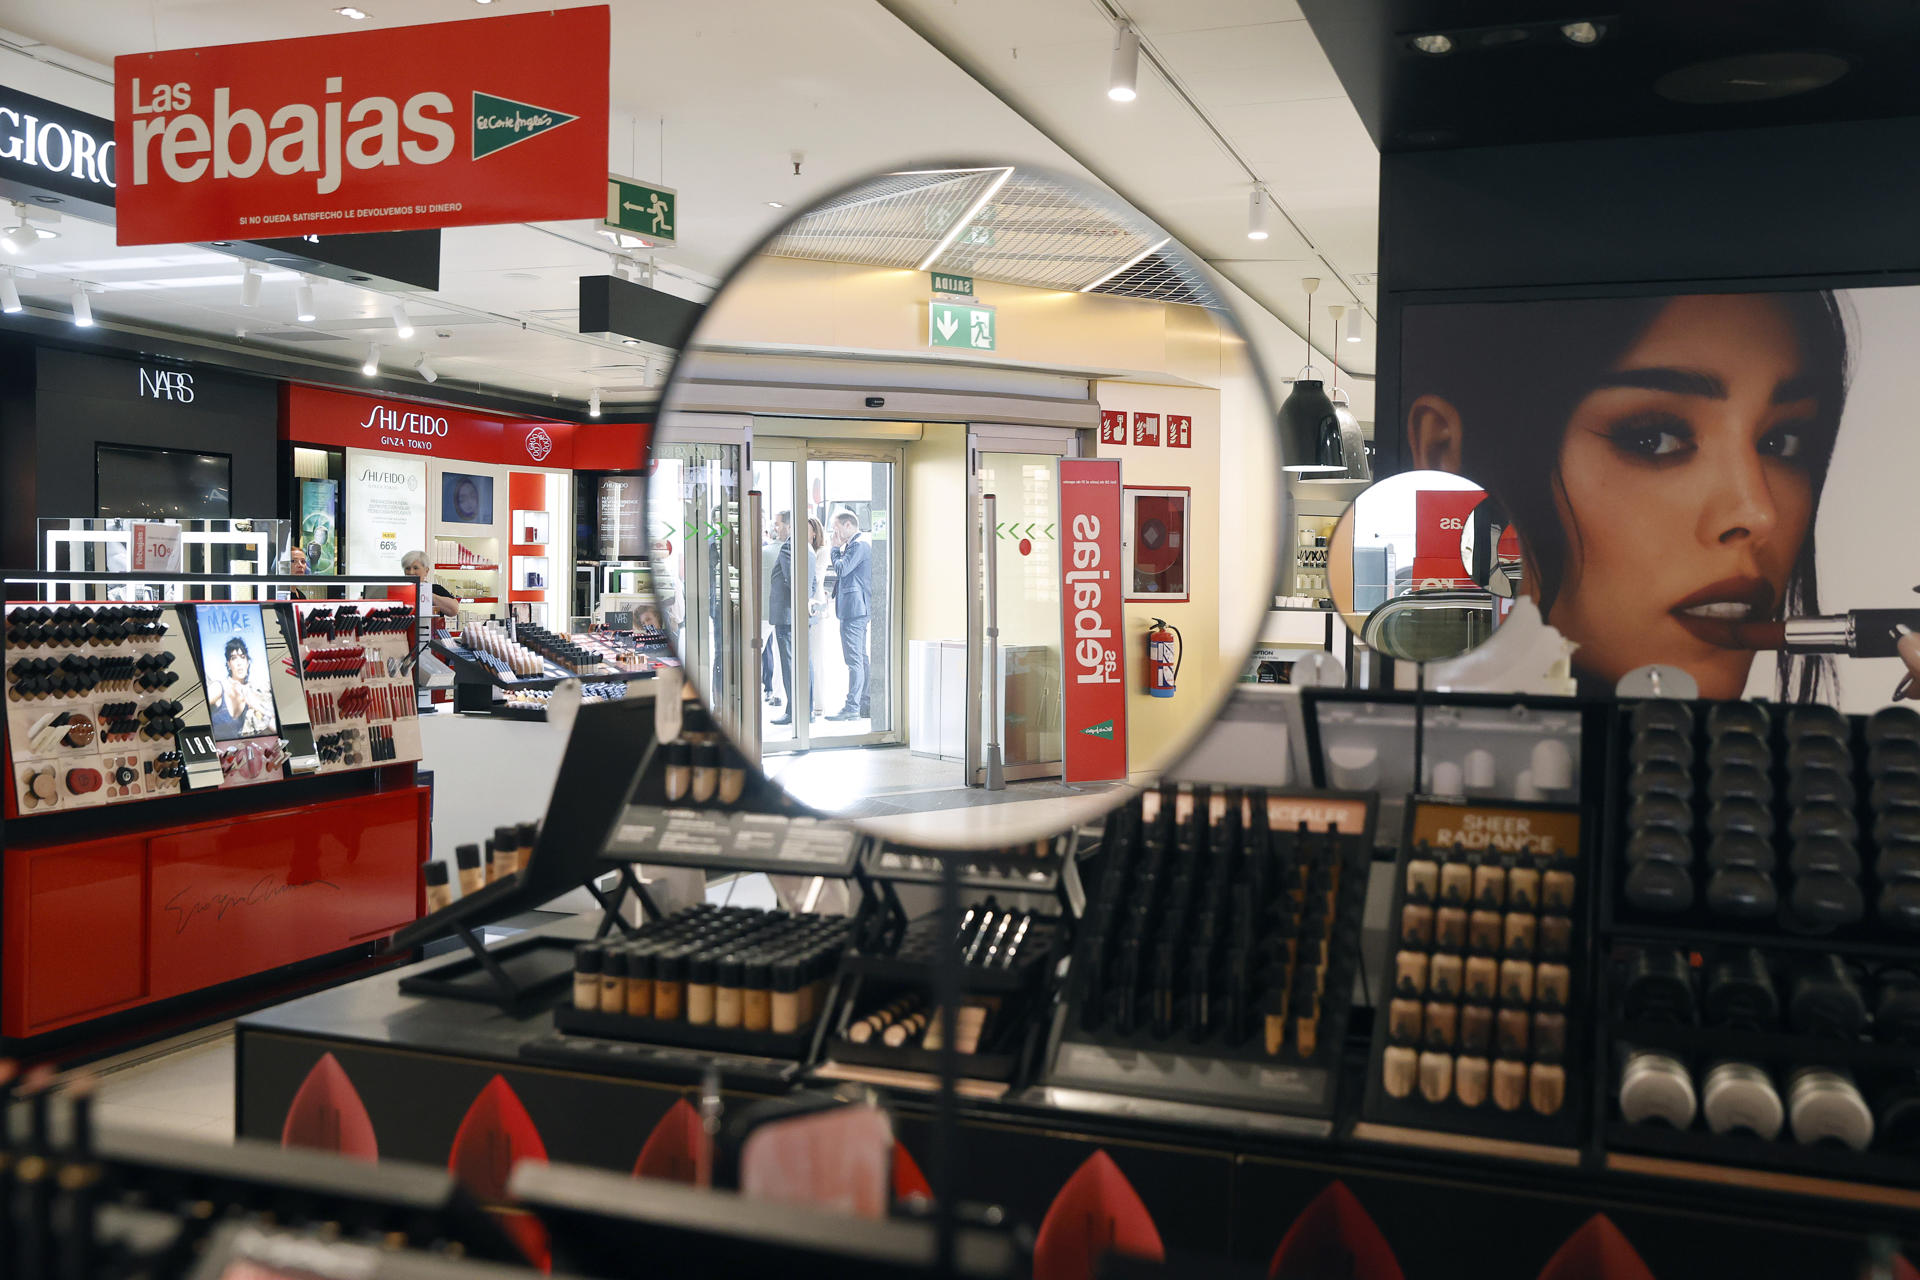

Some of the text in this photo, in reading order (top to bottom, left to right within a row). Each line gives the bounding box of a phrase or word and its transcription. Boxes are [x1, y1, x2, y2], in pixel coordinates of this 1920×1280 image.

[131, 78, 192, 115] Las
[476, 110, 553, 132] El Corte Inglés
[131, 76, 456, 195] rebajas
[240, 202, 463, 225] SI NO QUEDA SATISFECHO LE DEVOLVEMOS SU DINERO
[140, 367, 194, 403] NARS
[360, 405, 449, 437] SHISEIDO
[381, 435, 432, 451] GINZA TOKYO
[359, 468, 405, 485] SHISEIDO
[380, 541, 398, 551] 66%
[208, 609, 251, 632] MARE
[1462, 813, 1531, 835] SHEER
[1436, 827, 1555, 853] RADIANCE
